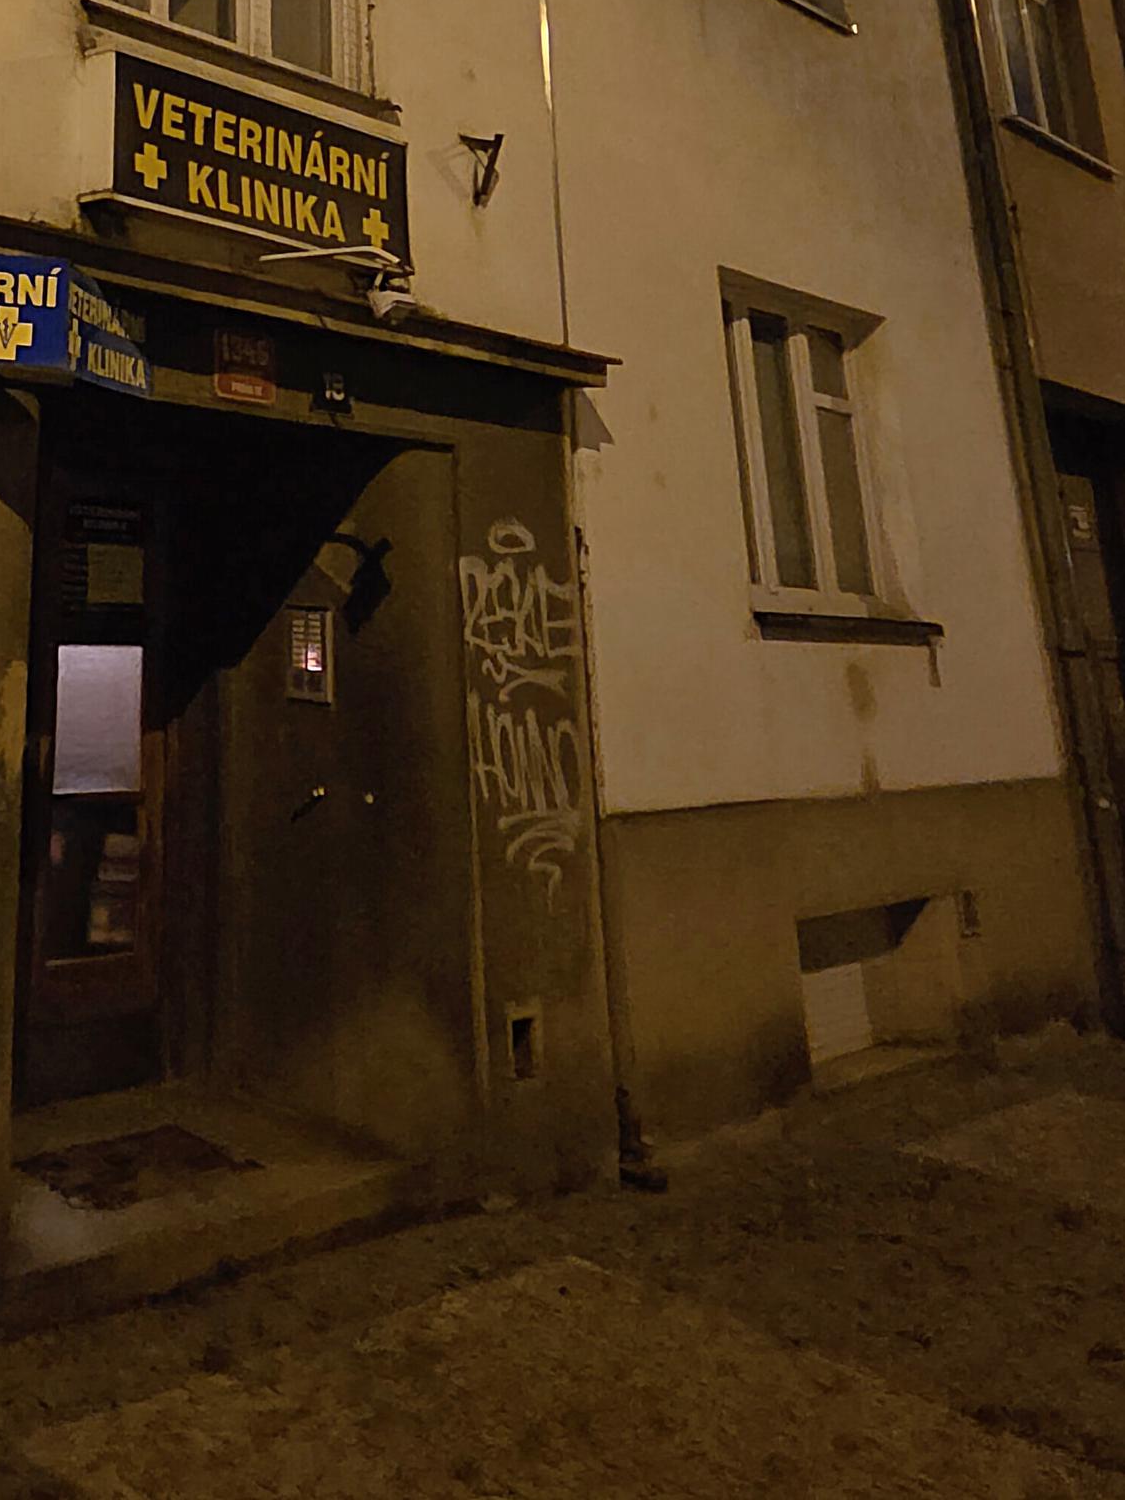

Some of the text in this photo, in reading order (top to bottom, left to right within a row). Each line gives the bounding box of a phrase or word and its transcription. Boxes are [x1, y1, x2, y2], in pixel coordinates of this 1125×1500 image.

[133, 82, 390, 201] VETERINÁRNÍ
[187, 160, 346, 243] KLINIKA
[86, 340, 147, 389] KLINIKA
